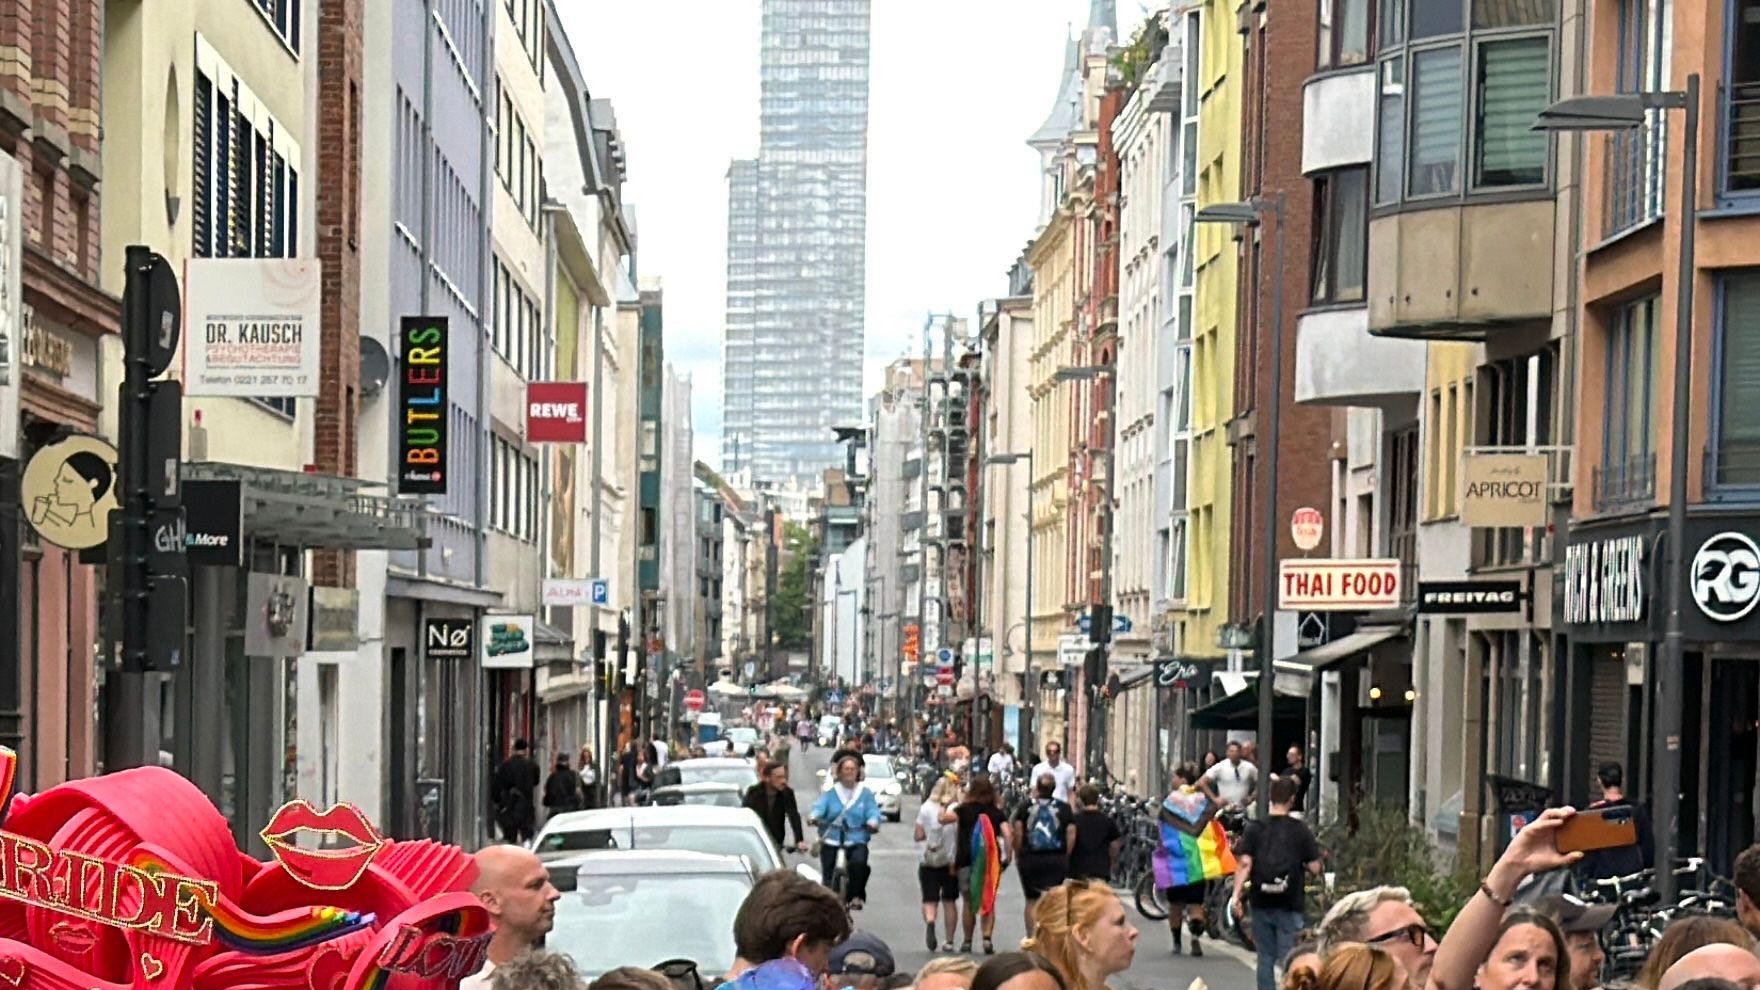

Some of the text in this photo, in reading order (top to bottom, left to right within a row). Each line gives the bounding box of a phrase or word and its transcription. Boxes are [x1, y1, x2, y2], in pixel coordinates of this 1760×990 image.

[206, 323, 303, 344] DR. KAUSCH
[406, 327, 441, 464] BUTLERS
[531, 402, 578, 418] REWE
[1466, 481, 1544, 498] APRICOT
[1283, 572, 1397, 597] THAI FOOD
[1600, 534, 1643, 622] GREENS
[1424, 591, 1515, 604] FREITAG
